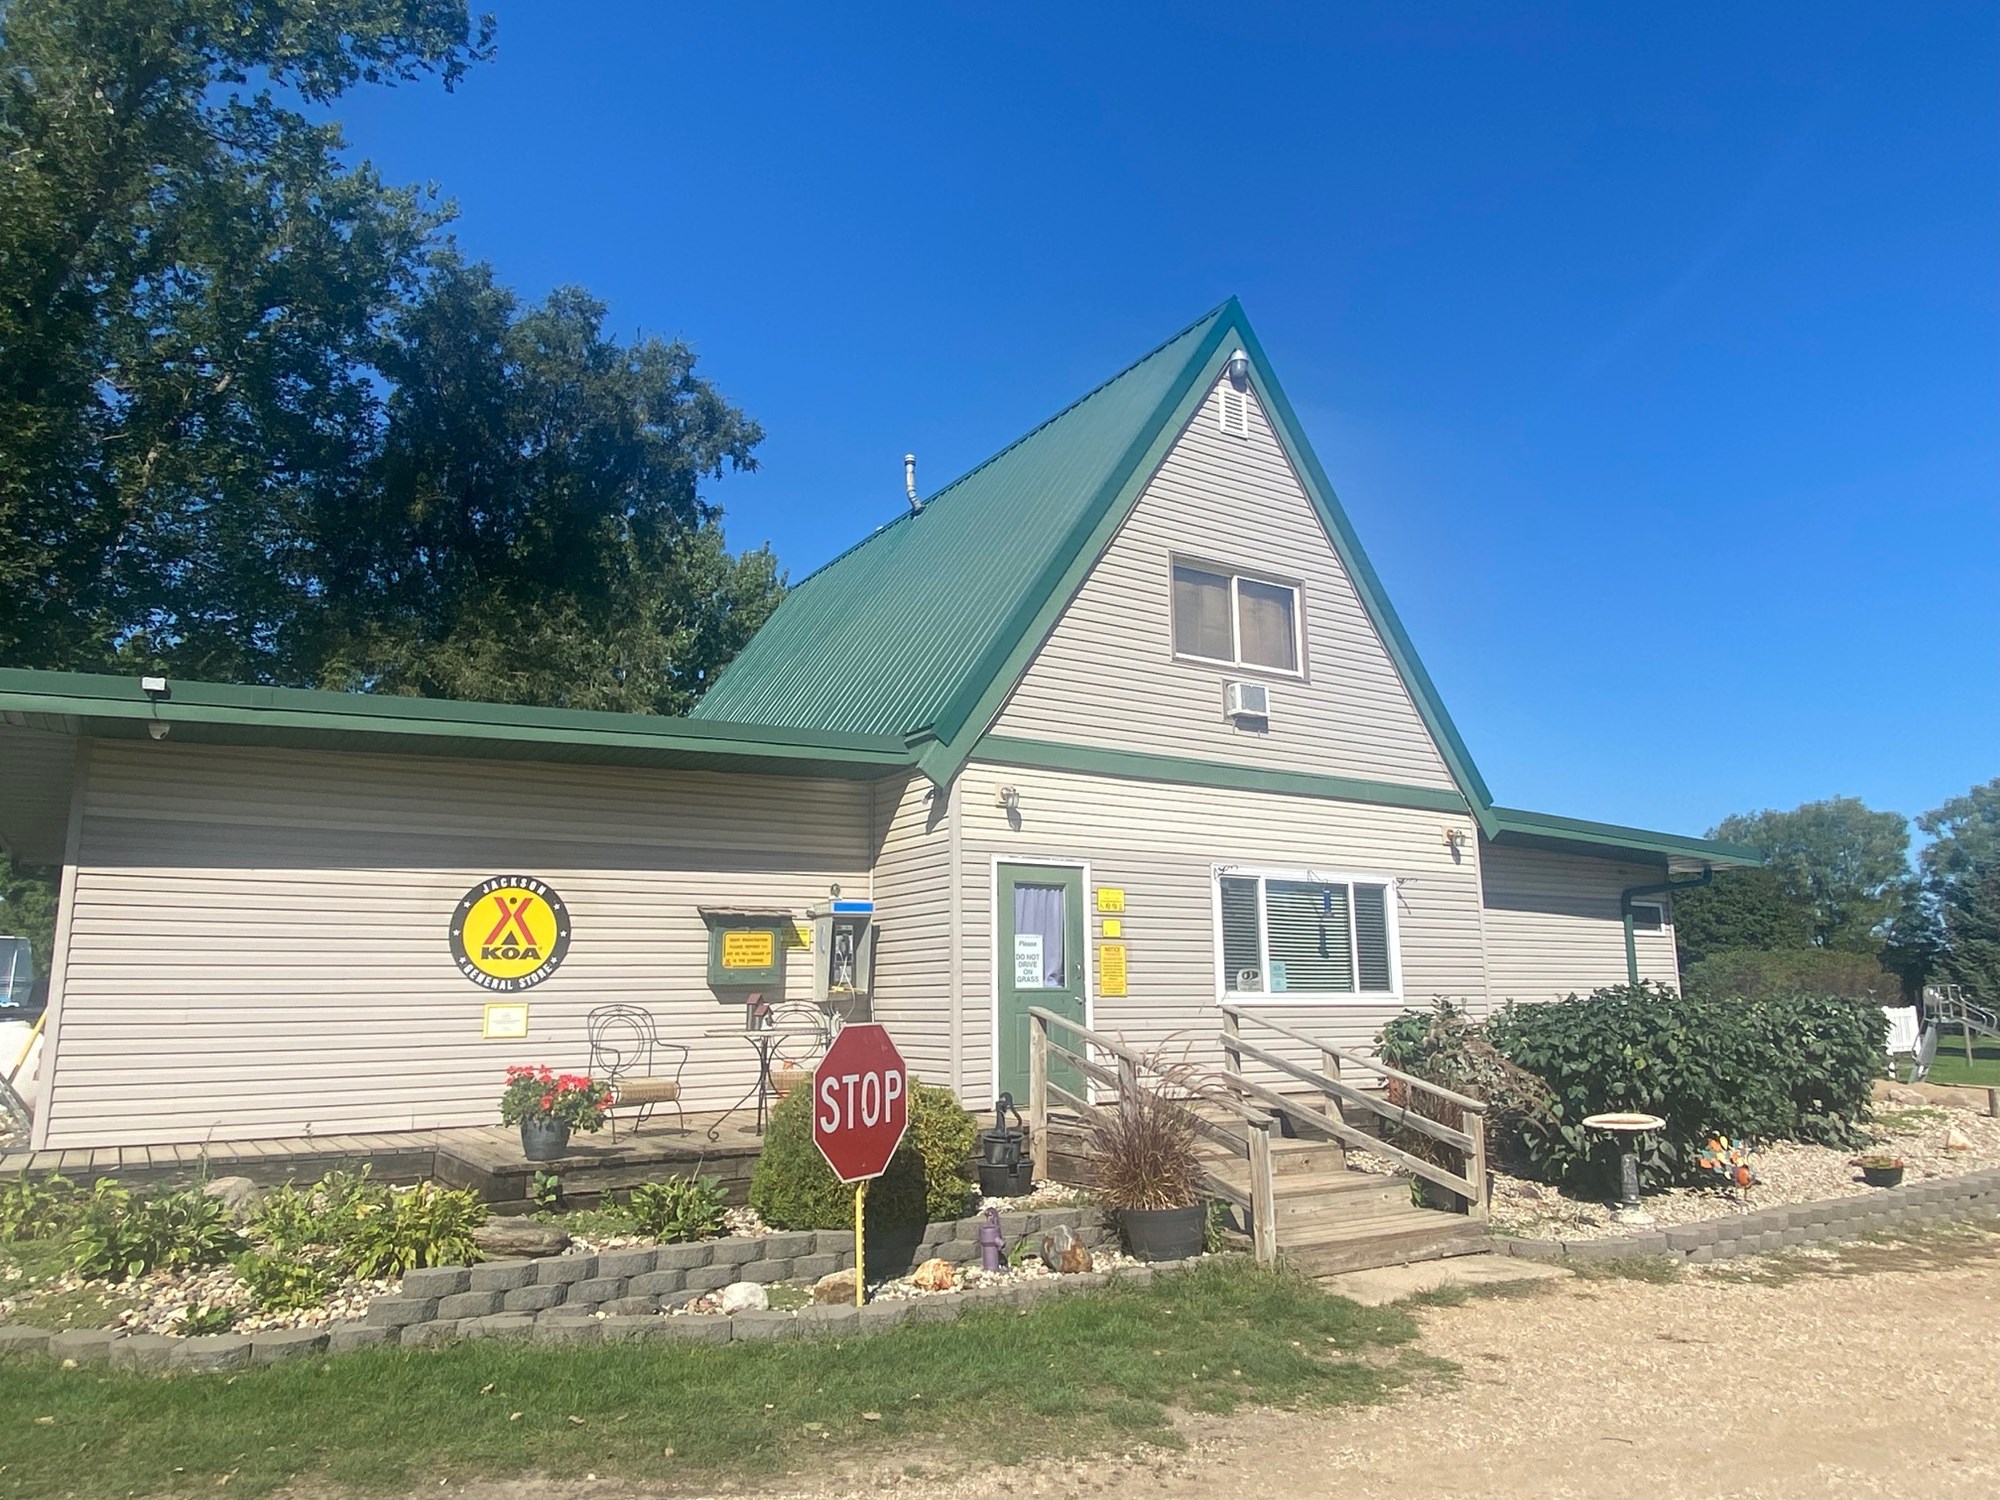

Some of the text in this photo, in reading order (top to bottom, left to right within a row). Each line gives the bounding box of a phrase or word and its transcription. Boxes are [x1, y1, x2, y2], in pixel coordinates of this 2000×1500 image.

[482, 877, 547, 896] JACKSON
[481, 947, 541, 960] KOA
[463, 963, 553, 990] GENERAL STORE
[820, 1069, 902, 1134] STOP
